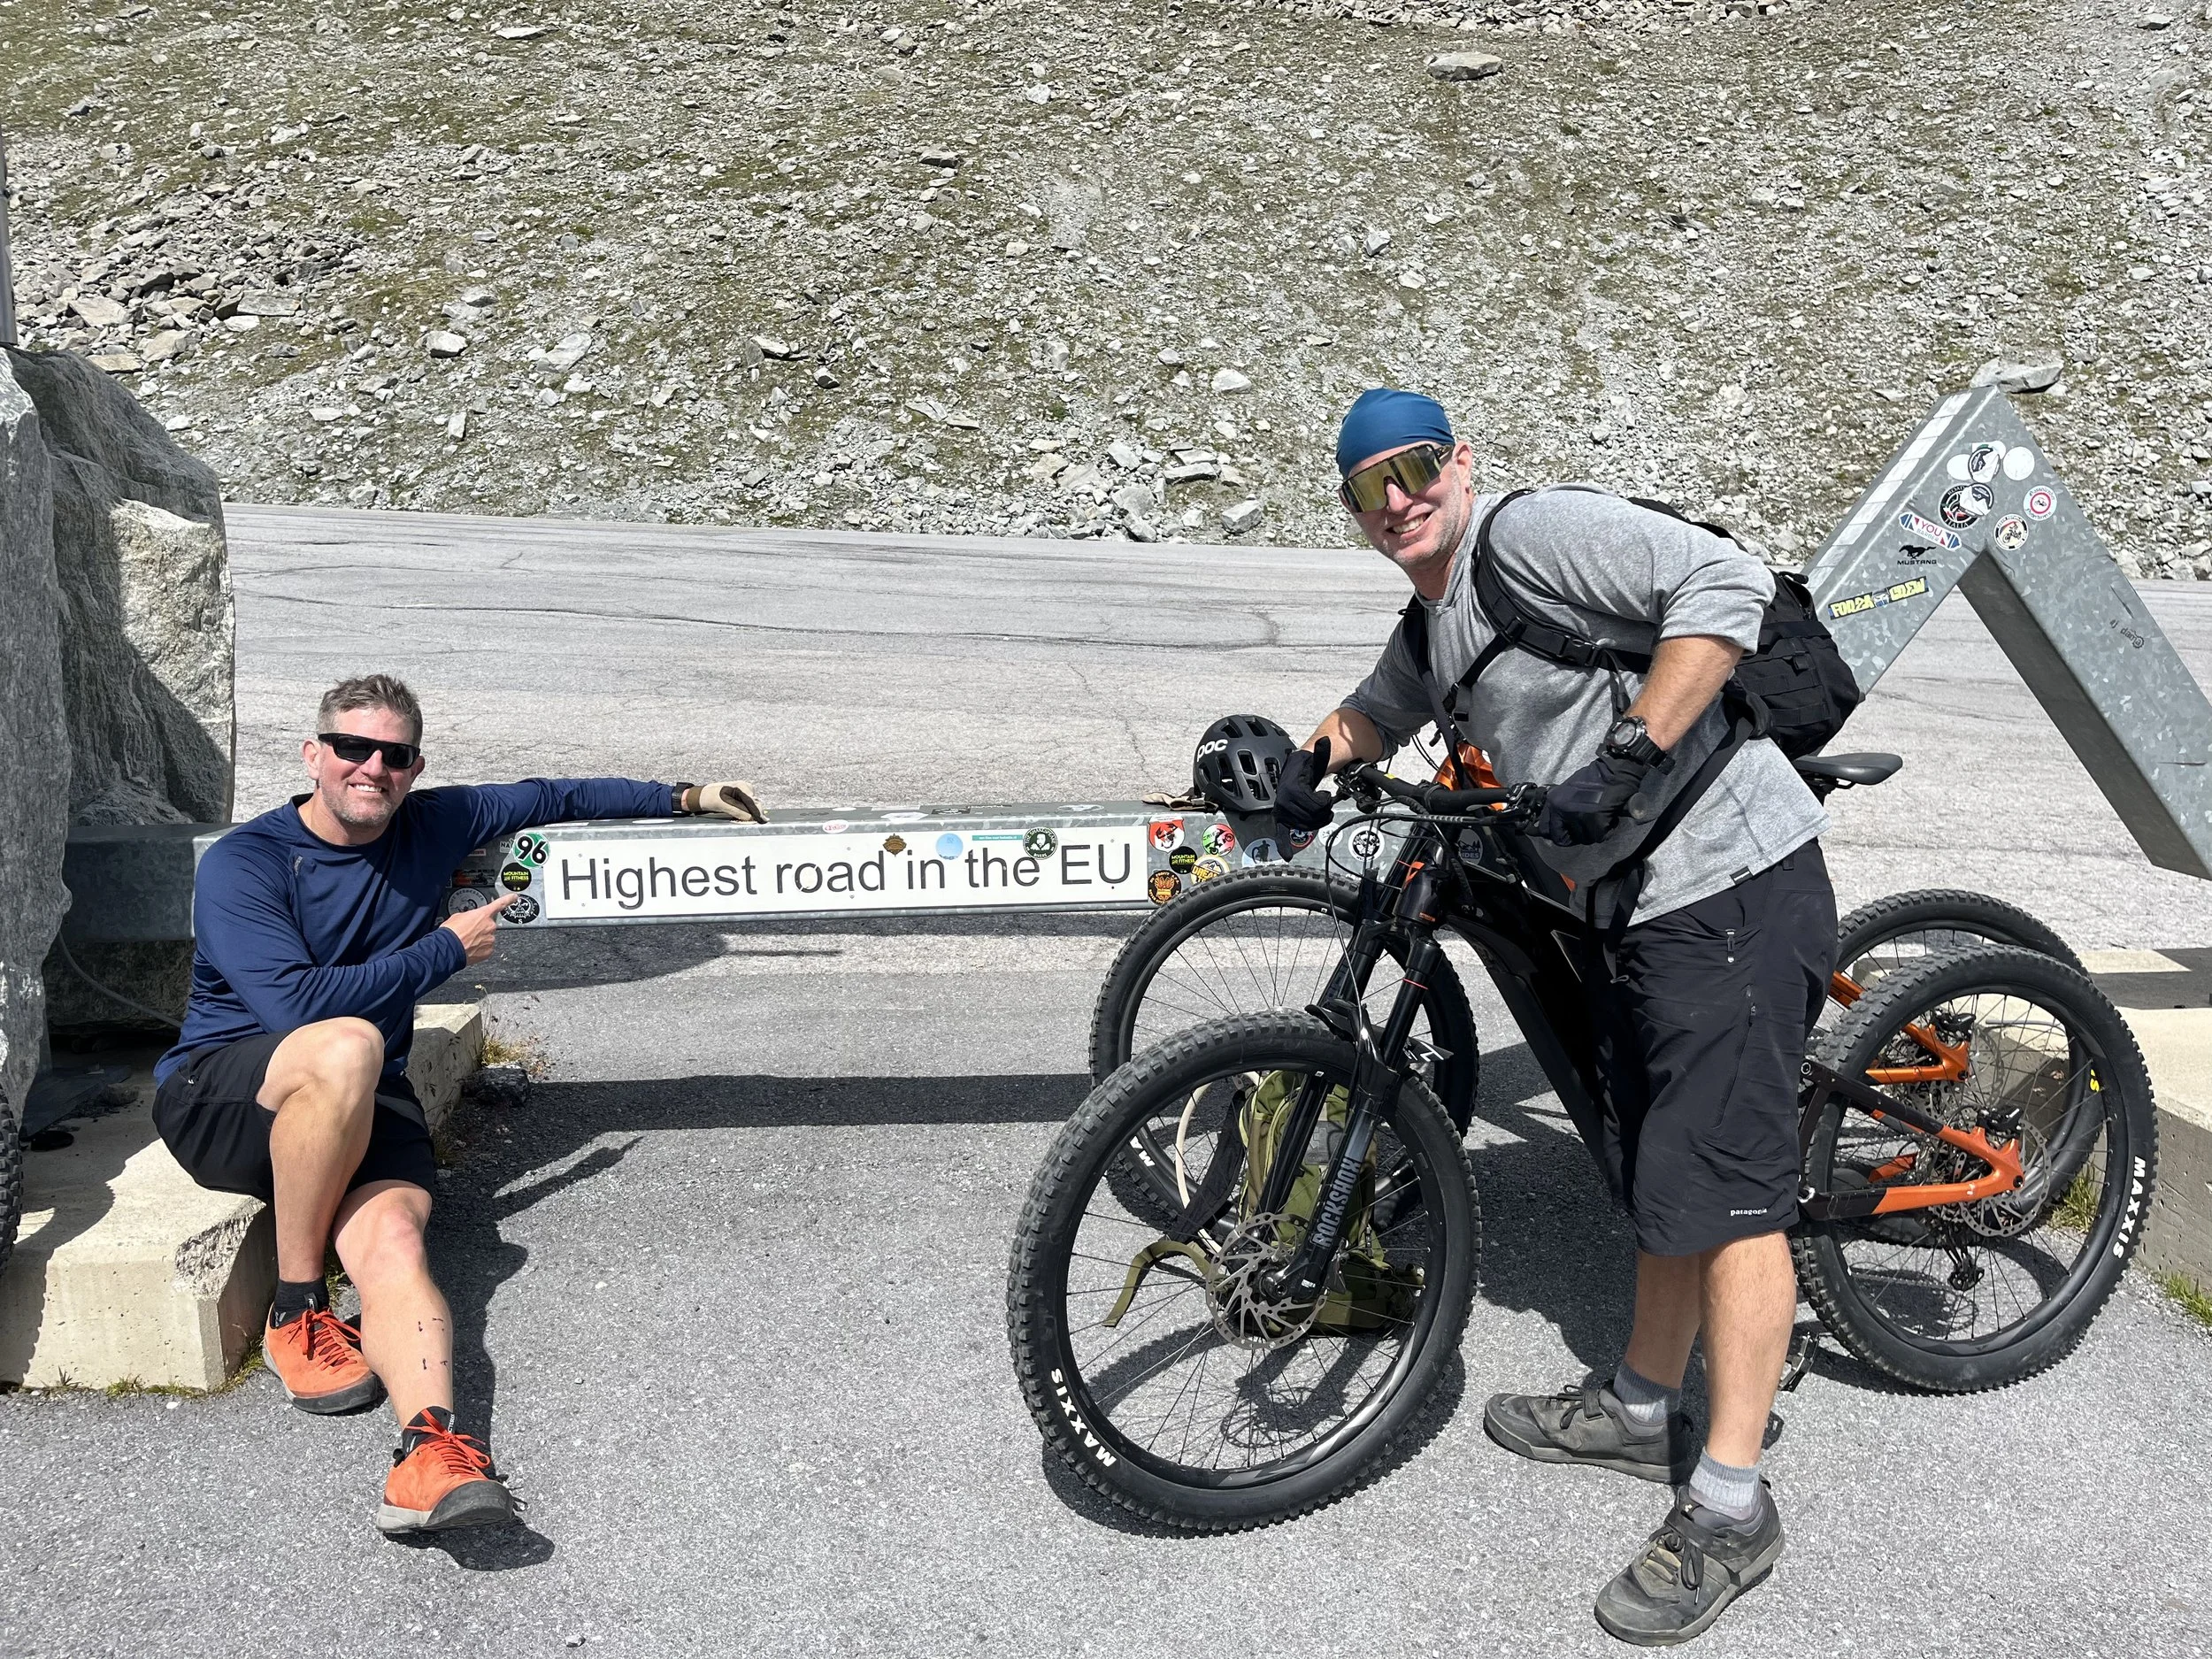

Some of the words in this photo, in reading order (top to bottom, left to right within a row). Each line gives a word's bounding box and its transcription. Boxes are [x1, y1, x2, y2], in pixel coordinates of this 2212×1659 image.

[1918, 521, 1943, 537] YOU
[518, 835, 547, 864] 96
[562, 856, 758, 910] Highest
[776, 849, 885, 895] road
[908, 849, 946, 890] in
[964, 848, 1041, 888] the
[1062, 843, 1131, 885] EU
[1312, 1157, 1363, 1248] ROCKSHOX
[2113, 1156, 2147, 1259] MAXXIS
[1050, 1368, 1117, 1467] MAXXIS
